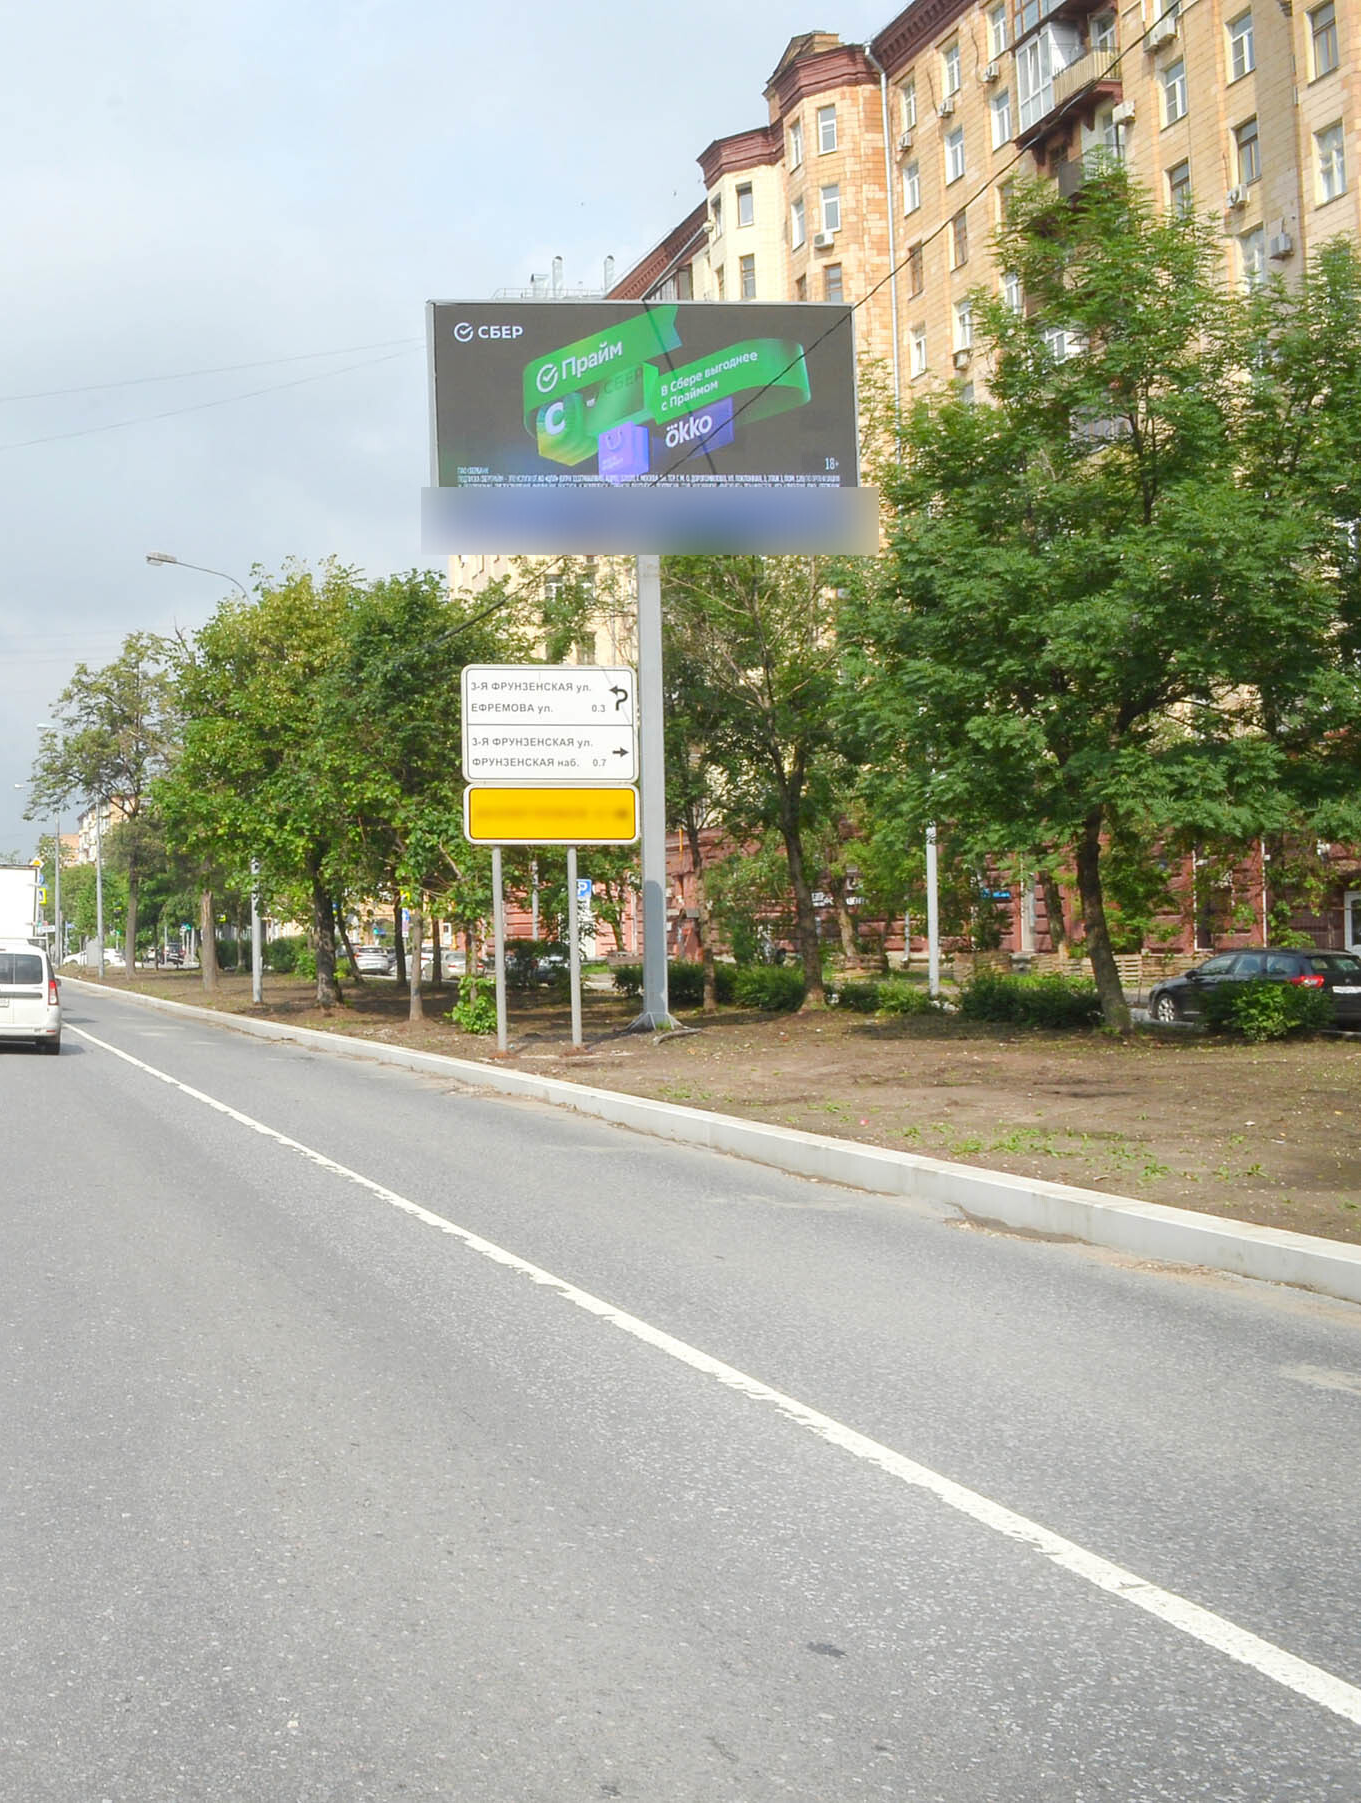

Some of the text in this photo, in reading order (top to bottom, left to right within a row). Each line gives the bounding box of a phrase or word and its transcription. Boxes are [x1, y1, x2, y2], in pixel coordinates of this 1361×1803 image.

[478, 325, 524, 339] СБЕР
[561, 341, 623, 379] Прайм
[661, 352, 758, 397] В Сбере выгоднее
[670, 381, 718, 408] Праймом
[825, 457, 839, 470] 18+
[471, 682, 592, 694] 3-Я ФРУНЗЕНСКАЯ ул.
[471, 703, 606, 715] ЕФРЕМОВА ул. 0.3
[472, 737, 593, 749] 3-Я ФРУНЗЕНСКАЯ ул.
[472, 758, 607, 767] ФРУНЗЕНСКАЯ наб. 0.7
